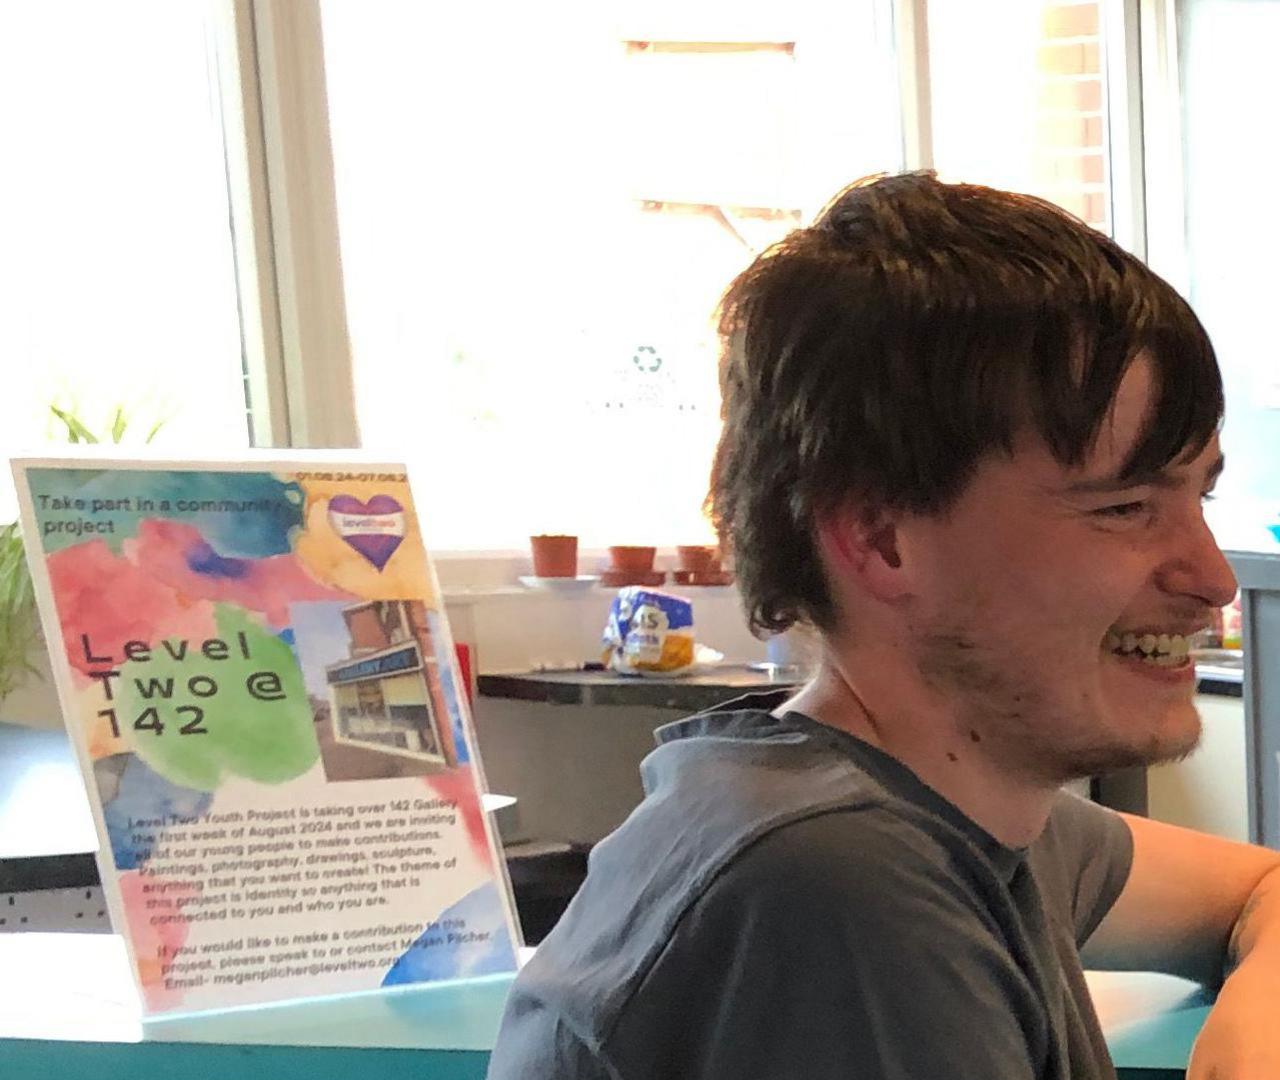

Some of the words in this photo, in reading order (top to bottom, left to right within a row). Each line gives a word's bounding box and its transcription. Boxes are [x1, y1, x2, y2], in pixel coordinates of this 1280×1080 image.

[37, 494, 86, 511] Take
[92, 497, 131, 515] part
[136, 498, 154, 512] in
[159, 500, 173, 512] a
[43, 518, 115, 537] project
[81, 630, 251, 664] Level
[87, 670, 219, 701] Two
[246, 671, 287, 701] @
[97, 704, 208, 739] 142
[128, 816, 167, 830] Level
[170, 813, 199, 826] Two
[203, 811, 244, 824] Youth
[247, 808, 297, 821] Project
[300, 807, 310, 819] is
[314, 804, 354, 818] taking
[357, 804, 386, 814] over
[390, 799, 410, 811] 142
[413, 797, 458, 811] Gallery
[131, 833, 156, 844] the
[159, 831, 188, 843] first
[192, 829, 227, 841] week
[231, 827, 245, 838] of
[248, 824, 297, 839] August
[300, 821, 333, 834] 2024
[336, 819, 361, 832] and
[364, 818, 383, 829] we
[386, 817, 407, 828] are
[409, 813, 457, 826] inviting
[174, 848, 197, 859] our
[201, 845, 245, 859] young
[247, 841, 295, 856] people
[298, 839, 312, 850] to
[315, 836, 351, 847] make
[142, 879, 205, 894] anything
[208, 876, 237, 889] that
[240, 874, 265, 888] you
[270, 871, 301, 884] want
[305, 869, 320, 880] to
[373, 863, 397, 875] The
[400, 859, 441, 872] theme
[443, 857, 458, 868] of
[146, 897, 172, 910] this
[176, 893, 227, 909] project
[230, 892, 242, 903] is
[245, 887, 298, 902] identity
[302, 886, 317, 897] so
[319, 879, 378, 895] anything
[381, 877, 407, 889] that
[410, 876, 420, 887] is
[149, 907, 228, 926] connected
[231, 907, 246, 919] to
[249, 905, 275, 919] you
[278, 902, 303, 915] and
[306, 899, 335, 912] who
[338, 898, 362, 911] you
[366, 896, 389, 907] are.
[157, 945, 168, 958] If
[172, 944, 198, 960] you
[201, 939, 244, 953] would
[247, 936, 272, 949] like
[275, 936, 289, 947] to
[293, 931, 329, 944] make
[332, 931, 340, 941] a
[343, 923, 424, 940] contribution
[426, 920, 440, 931] to
[442, 917, 466, 930] this
[219, 955, 266, 969] please
[269, 950, 309, 964] speak
[312, 948, 327, 960] to
[329, 948, 343, 958] or
[346, 942, 398, 956] contact
[400, 937, 444, 951] Megan
